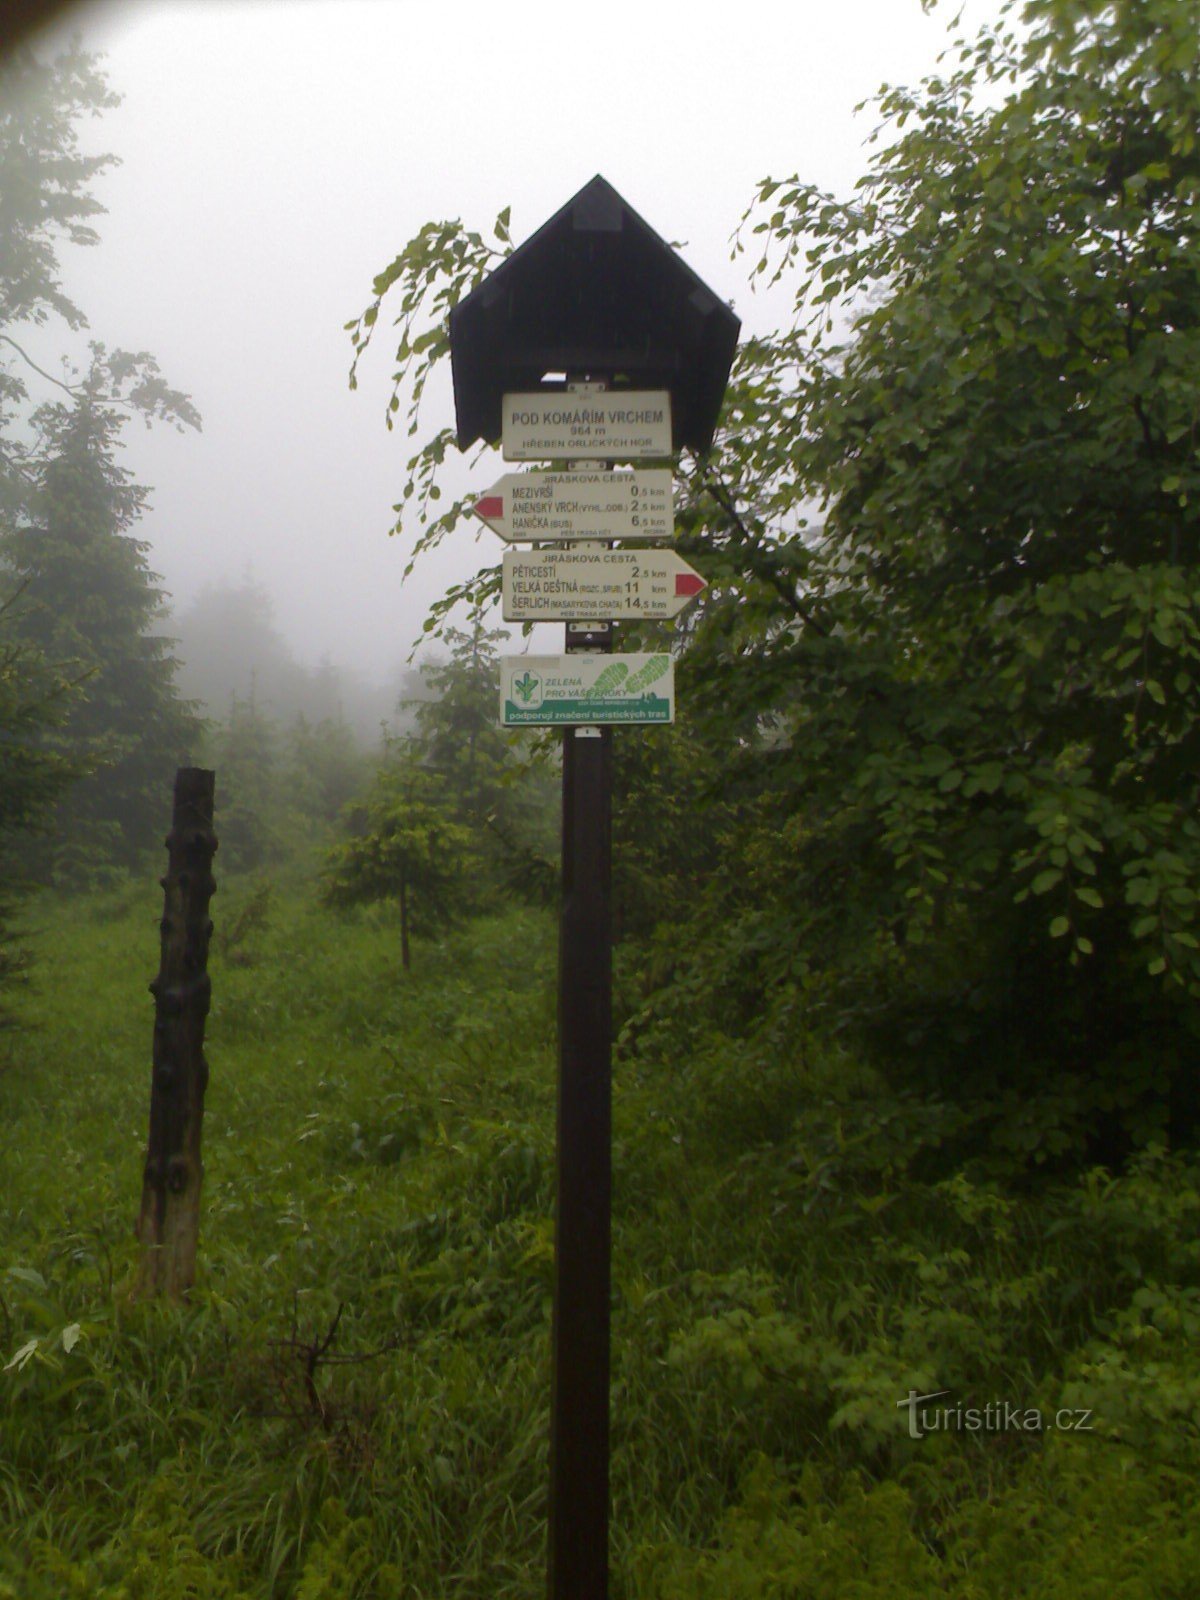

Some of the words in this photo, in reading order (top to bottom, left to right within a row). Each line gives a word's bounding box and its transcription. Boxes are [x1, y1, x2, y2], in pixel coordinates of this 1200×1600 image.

[512, 411, 539, 425] POD
[543, 409, 605, 425] KOMÁŘÍM
[608, 410, 664, 425] VRCHEM
[570, 426, 591, 436] 964
[522, 438, 565, 449] HŘEBEN
[568, 437, 627, 448] ORLICKÝCH
[631, 438, 653, 447] HOR
[543, 474, 600, 484] JIRÁSKOVA
[603, 473, 636, 483] CESTA
[512, 486, 553, 499] MEZIVRŠÍ
[650, 488, 665, 496] km
[512, 501, 552, 513] ANENSKÝ
[555, 502, 579, 513] VRCH
[650, 502, 665, 511] km
[512, 515, 549, 529] HANIČKA
[650, 518, 665, 526] km
[542, 554, 600, 564] JIRÁSKOVA
[603, 554, 637, 563] CESTA
[512, 566, 556, 578] PĚTICESTÍ
[651, 569, 667, 578] km
[512, 580, 541, 593] VELKÁ
[543, 579, 578, 593] DEŠTNÁ
[625, 582, 639, 593] 11
[651, 584, 667, 593] km
[512, 596, 550, 609] ŠERLICH
[651, 600, 667, 609] km
[545, 677, 582, 686] ZELENÁ
[545, 689, 566, 698] PRO
[594, 689, 628, 697] KROKY
[509, 710, 553, 721] podporují
[554, 710, 590, 719] značení
[592, 710, 646, 720] turistických
[648, 710, 667, 719] tras
